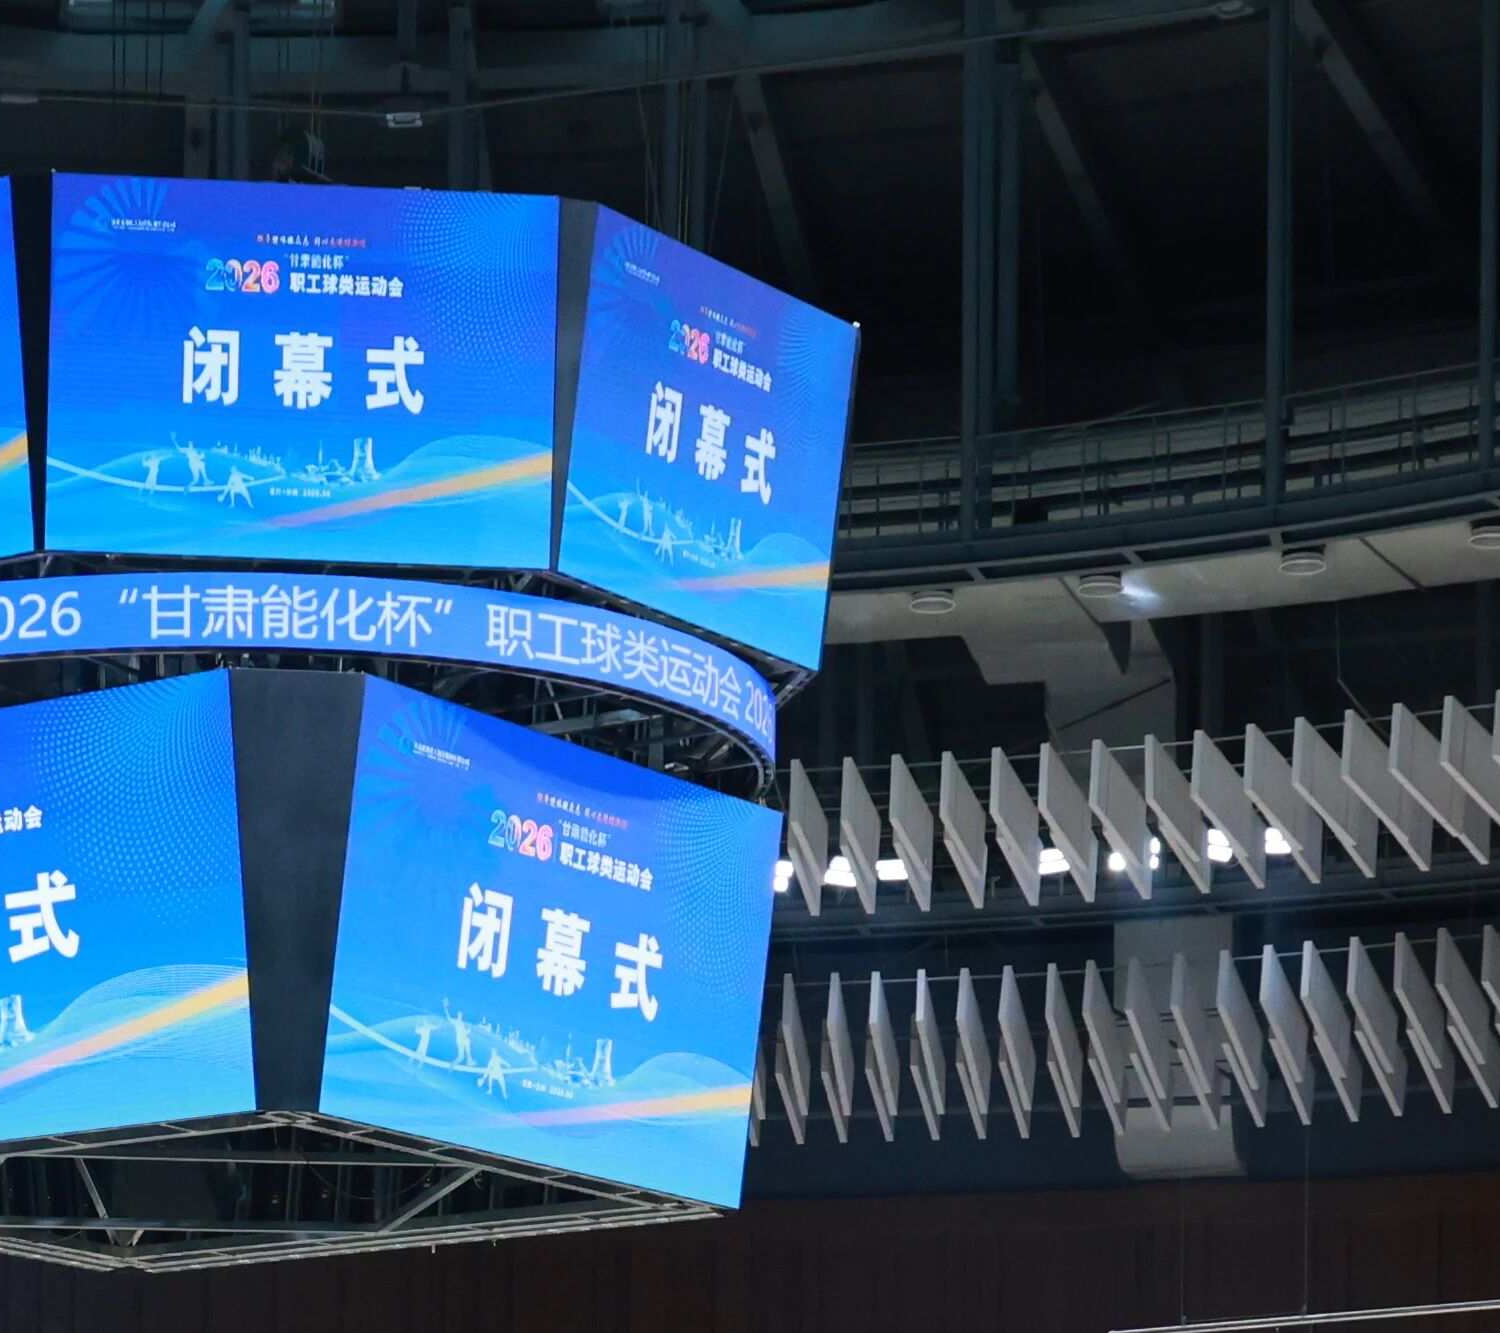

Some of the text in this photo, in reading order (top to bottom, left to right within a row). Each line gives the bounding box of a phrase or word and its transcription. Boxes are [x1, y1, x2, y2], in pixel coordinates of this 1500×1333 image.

[205, 258, 280, 294] 2026
[289, 273, 404, 298] 职工球类运动会
[181, 326, 425, 415] 闭幕式
[645, 380, 776, 505] 闭幕式
[118, 586, 454, 648] “甘肃能化杯”
[486, 603, 741, 721] 职工球类运动会
[487, 808, 554, 862] 2026
[559, 842, 654, 893] 职工球类运动会
[457, 882, 664, 1023] 闭幕式
